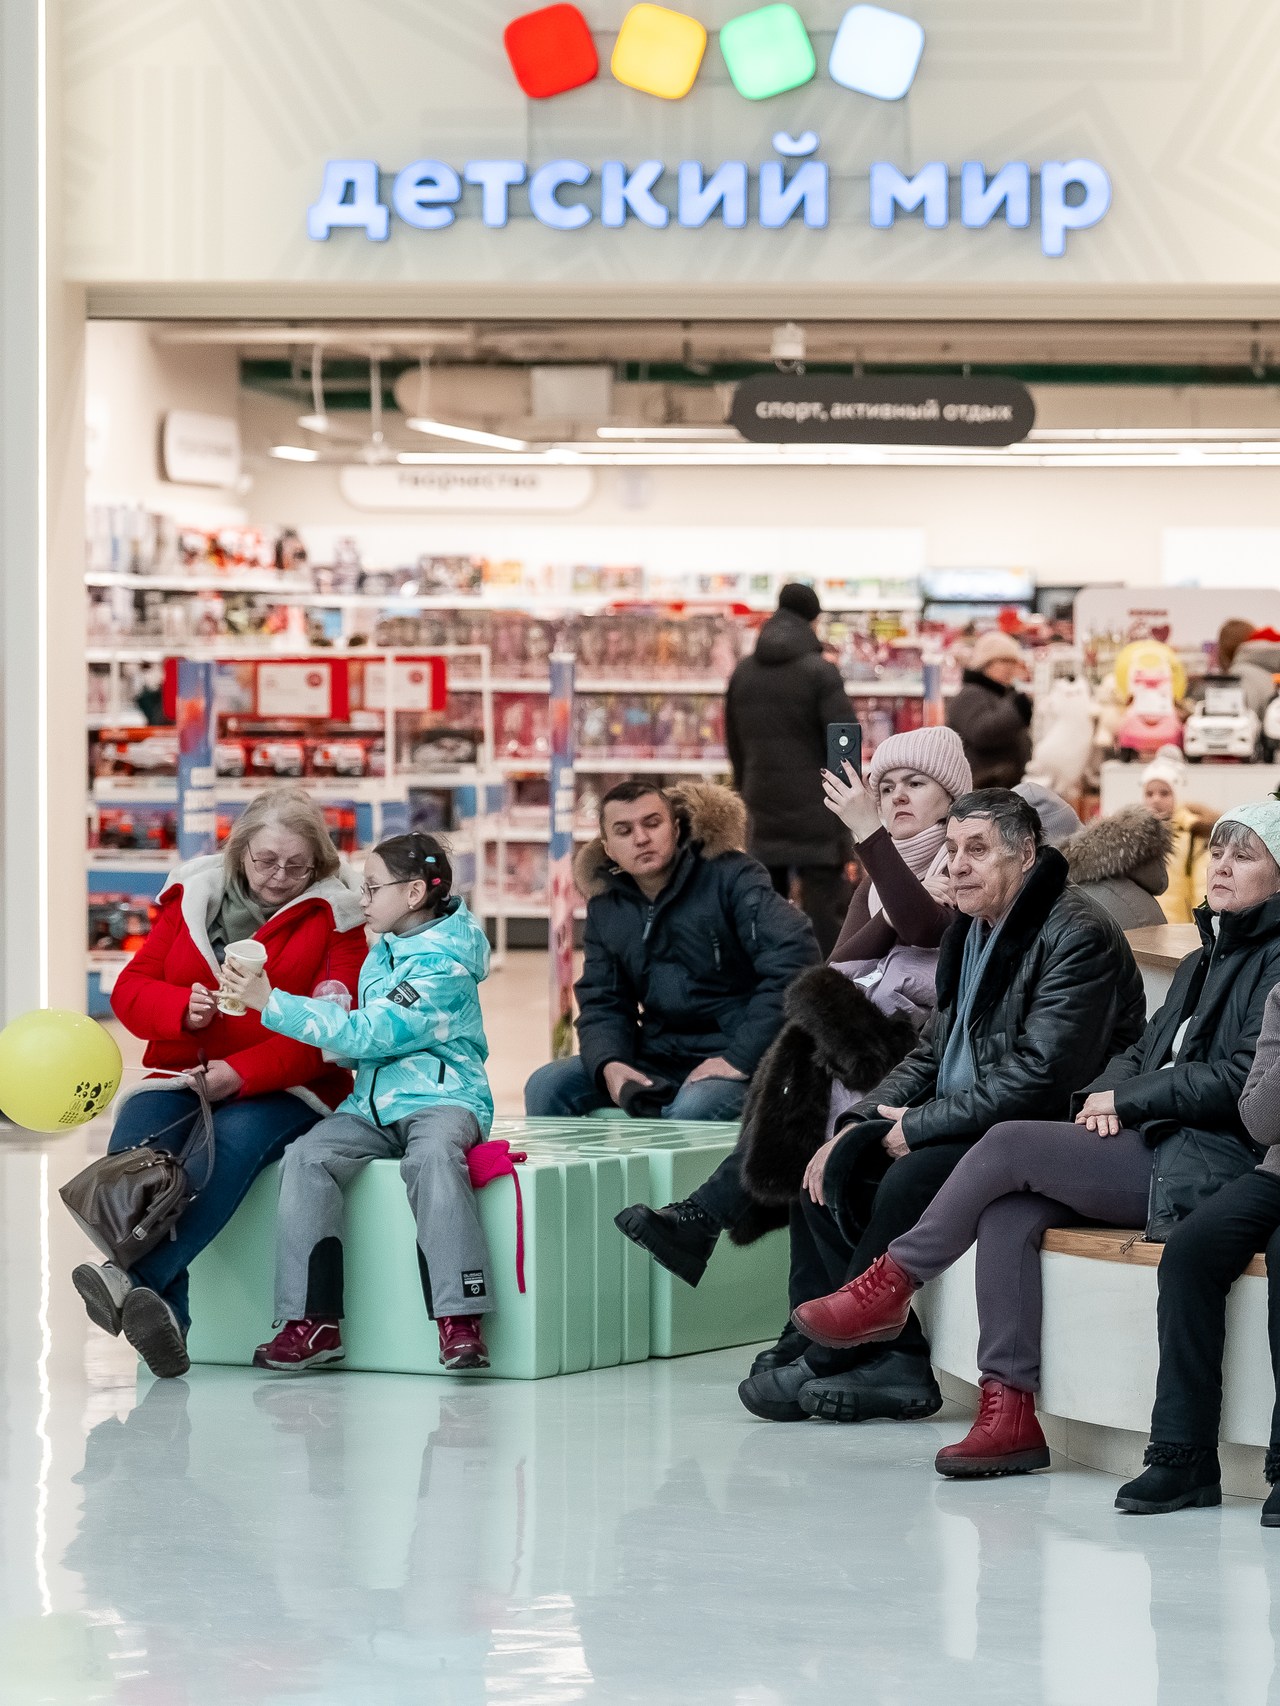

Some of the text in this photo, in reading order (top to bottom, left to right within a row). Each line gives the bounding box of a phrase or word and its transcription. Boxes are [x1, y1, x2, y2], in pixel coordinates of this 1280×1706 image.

[307, 130, 1113, 259] детский мир
[755, 399, 1014, 423] спорт, активный отдых
